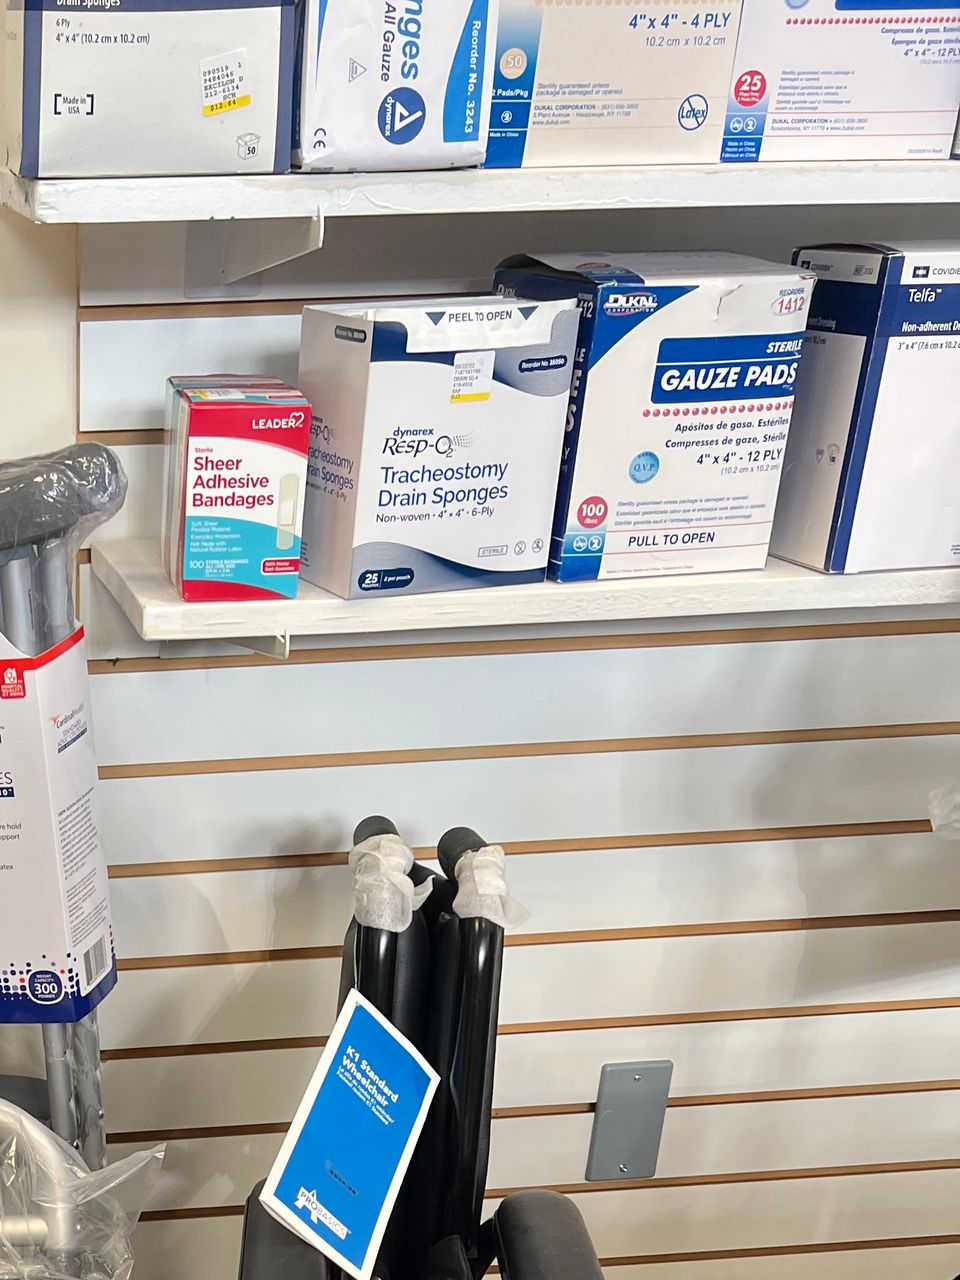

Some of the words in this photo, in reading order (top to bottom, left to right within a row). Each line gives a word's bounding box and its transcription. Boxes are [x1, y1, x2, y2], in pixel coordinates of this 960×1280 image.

[384, 1, 397, 25] All
[660, 13, 678, 29] 4"
[690, 13, 700, 29] 4
[703, 12, 731, 28] PLY
[61, 18, 71, 28] Ply
[81, 33, 99, 44] (10.2
[100, 36, 112, 44] cm
[120, 33, 135, 44] 10.2
[136, 33, 151, 45] cm)
[469, 20, 481, 70] Reorder
[644, 36, 665, 47] 10.2
[666, 37, 680, 47] cm
[693, 36, 712, 46] 10.2
[713, 36, 726, 46] cm
[380, 30, 395, 82] Gauze
[937, 48, 947, 57] 12
[505, 55, 523, 68] 50
[467, 73, 479, 95] No.
[739, 75, 762, 91] 25
[62, 96, 79, 105] Made
[80, 96, 87, 105] in
[497, 88, 529, 98] Pads/Pkg
[68, 105, 80, 114] USA
[384, 96, 395, 137] dynarex
[464, 100, 476, 134] 3243
[680, 105, 706, 119] Latex
[247, 146, 256, 155] 50
[605, 294, 659, 309] DUKAL
[777, 297, 805, 313] 1412
[448, 312, 474, 323] PEEL
[475, 312, 484, 322] TO
[486, 310, 513, 322] OPEN
[901, 320, 951, 333] Non-adherent
[766, 338, 803, 353] STERILE
[660, 366, 741, 391] GAUZE
[743, 362, 799, 388] PADS
[251, 417, 296, 430] LEADER
[674, 421, 714, 433] Apósitos
[716, 420, 728, 430] de
[393, 426, 434, 439] dynarex
[665, 438, 719, 449] Compresses
[721, 436, 733, 446] de
[735, 436, 760, 448] gaze,
[193, 456, 242, 472] Sheer
[308, 447, 354, 474] racheostomy
[696, 453, 711, 465] 4"
[712, 456, 720, 465] x
[723, 452, 737, 464] 4"
[747, 450, 761, 463] 12
[763, 448, 783, 462] PLY
[321, 466, 354, 491] Sponges
[380, 462, 509, 485] Tracheostomy
[192, 473, 269, 490] Adhesive
[192, 492, 274, 509] Bandages
[378, 488, 427, 508] Drain
[431, 484, 508, 509] Sponges
[376, 512, 431, 524] Non-woven
[471, 506, 495, 518] 6-Ply
[581, 503, 605, 517] 100
[628, 535, 659, 547] PULL
[663, 534, 680, 545] TO
[682, 532, 715, 545] OPEN
[189, 560, 204, 569] 100
[363, 573, 380, 584] 25
[7, 822, 22, 830] hold
[34, 982, 58, 995] 300
[342, 1055, 389, 1107] Wheelchair
[346, 1045, 360, 1062] K1
[360, 1059, 399, 1103] Standard
[300, 1191, 346, 1237] PROBASICS
